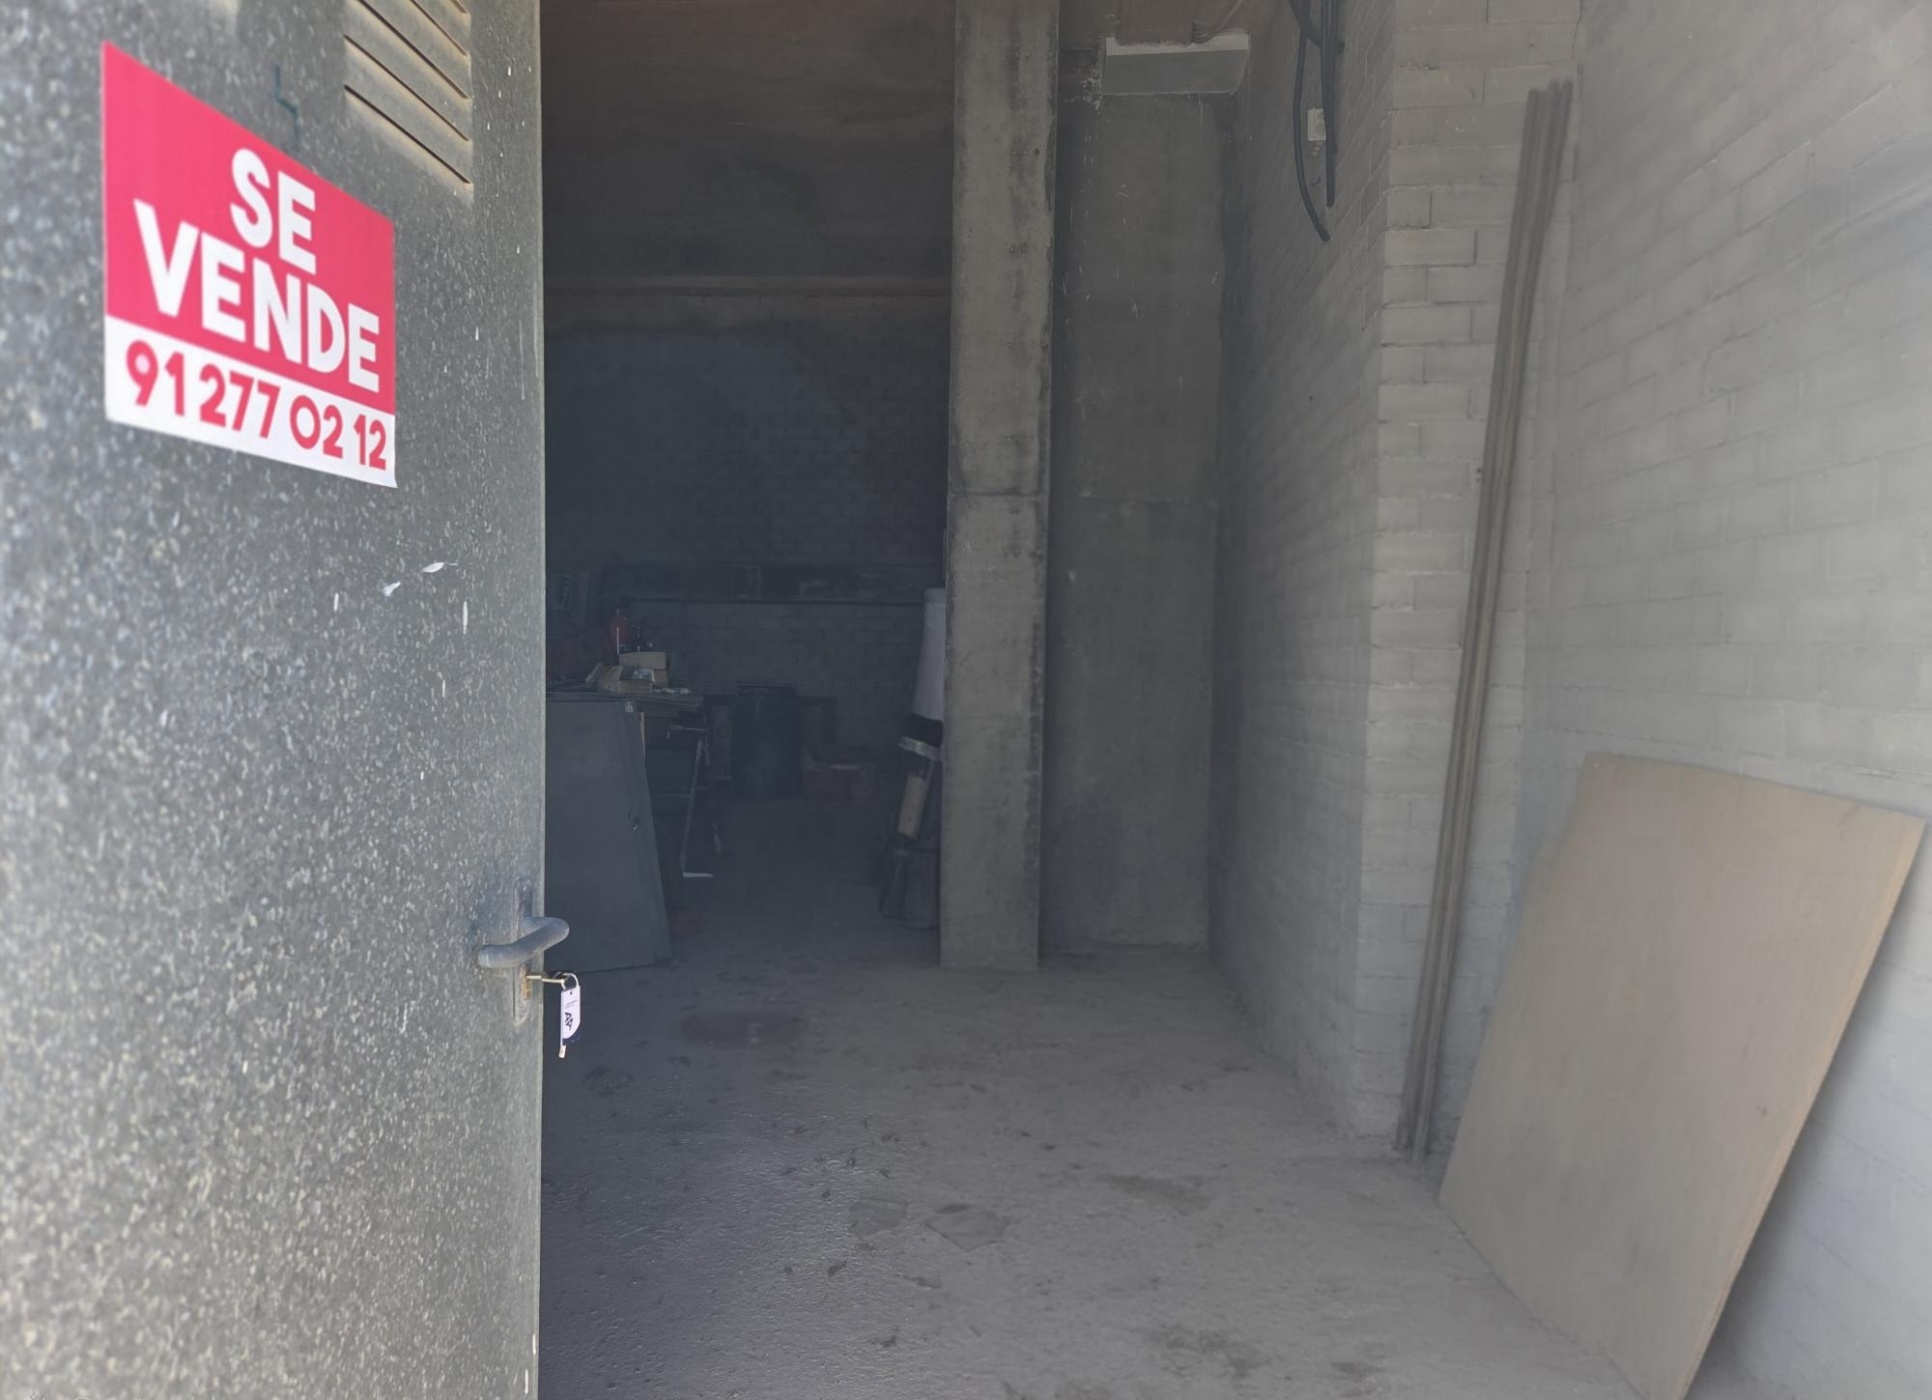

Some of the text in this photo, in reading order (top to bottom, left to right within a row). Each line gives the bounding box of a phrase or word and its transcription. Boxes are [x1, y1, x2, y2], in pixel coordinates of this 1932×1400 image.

[230, 148, 317, 275] SE
[133, 198, 380, 394] VENDE
[126, 339, 387, 470] 91 277 02 12
